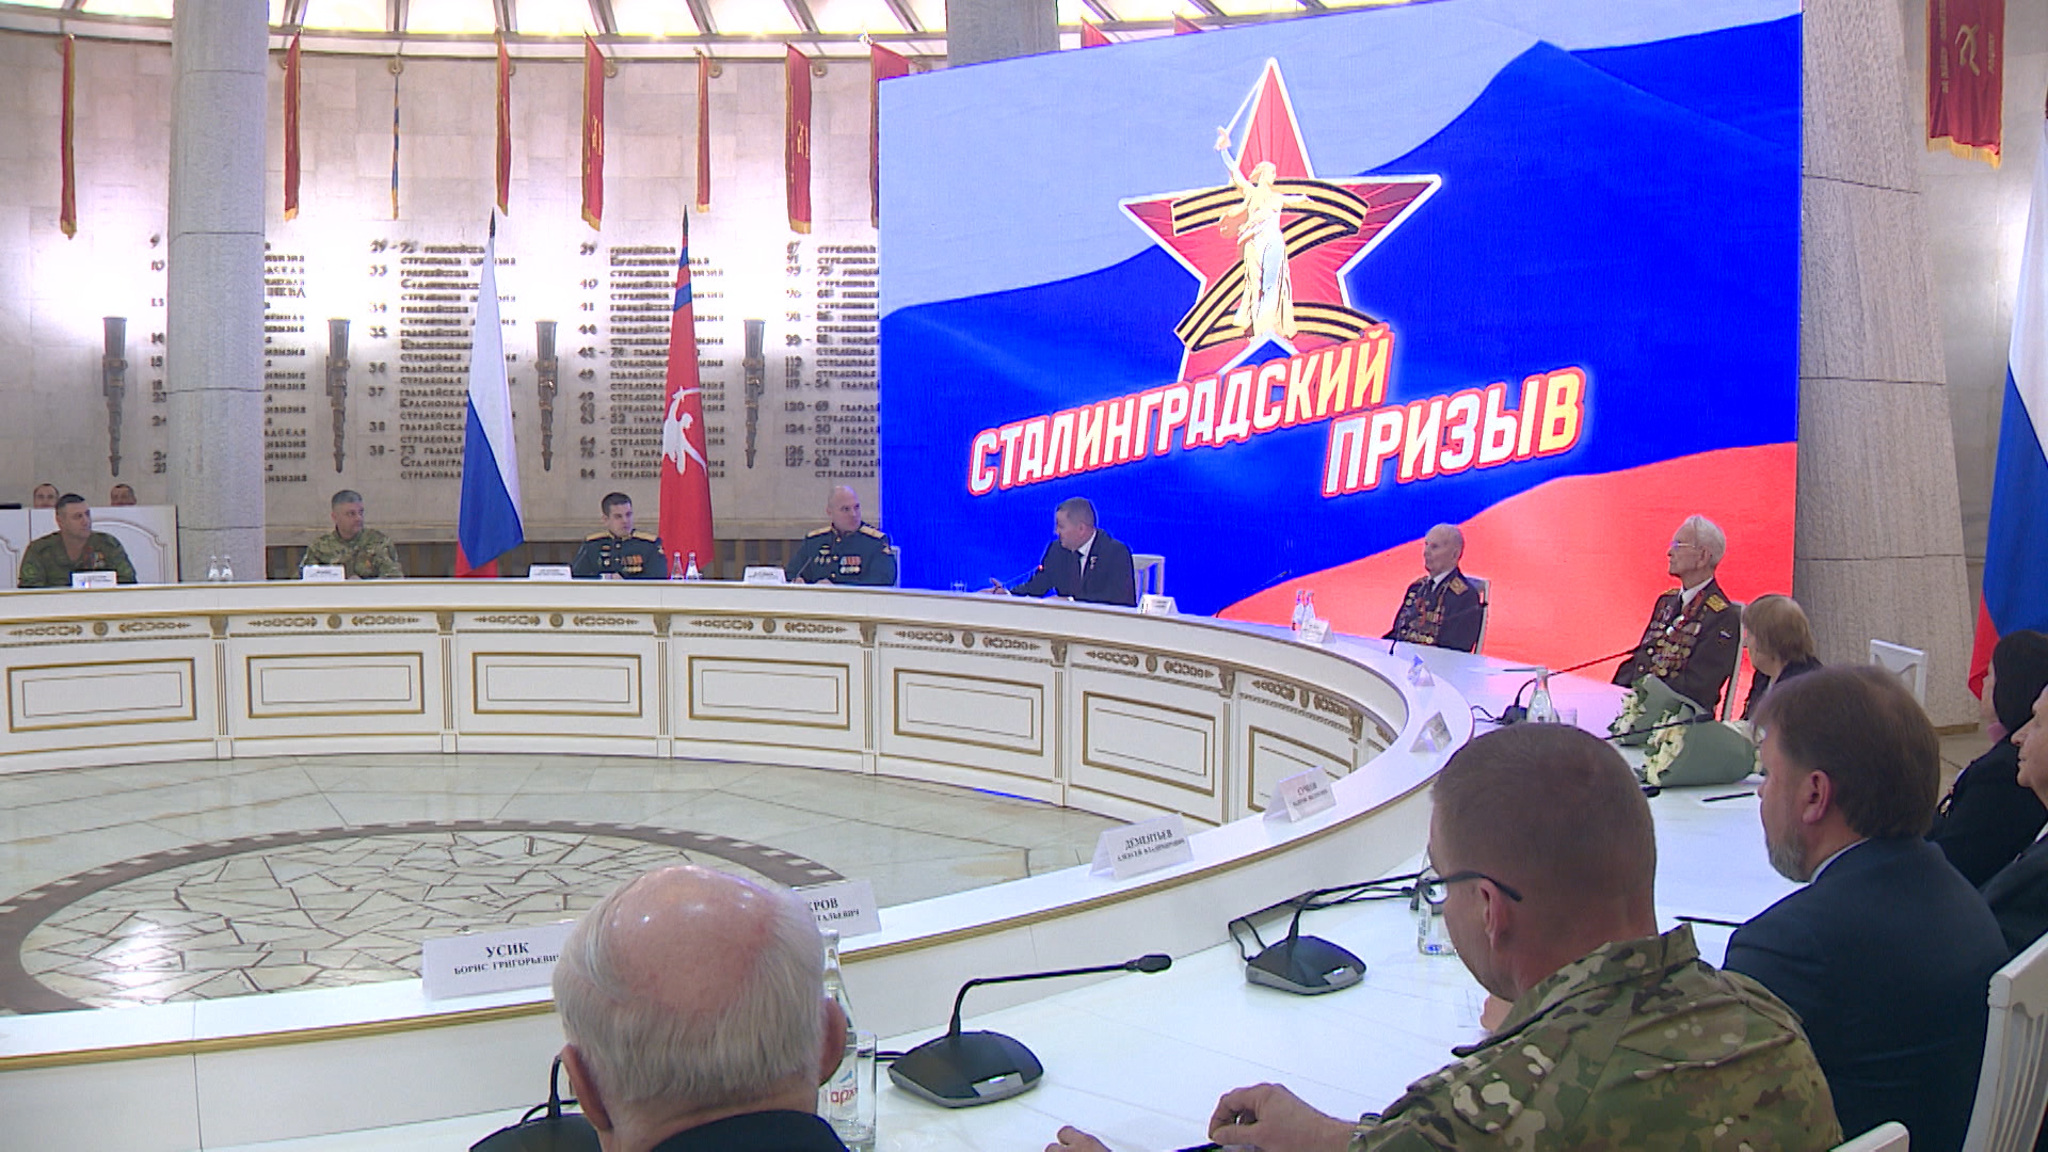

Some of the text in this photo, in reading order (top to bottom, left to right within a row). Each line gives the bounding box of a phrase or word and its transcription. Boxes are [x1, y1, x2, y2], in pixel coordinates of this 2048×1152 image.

[368, 386, 385, 397] 37
[609, 383, 665, 391] СТРЕЛКОВА
[609, 394, 665, 402] СТРЕЛКОВА
[609, 405, 665, 413] СТРЕЛКОВА
[969, 329, 1394, 495] СТАЛИНГРАДСКИЙ
[400, 423, 466, 431] ГВАРДЕЙСКА
[610, 427, 663, 436] СТРЕЛКОВА
[1324, 372, 1584, 495] ПРИЗЫВ
[610, 439, 663, 447] СТРЕЛКОВА
[400, 456, 463, 467] СТАЛИНГРА
[486, 942, 530, 958] УСИК
[454, 963, 489, 975] БОРИС
